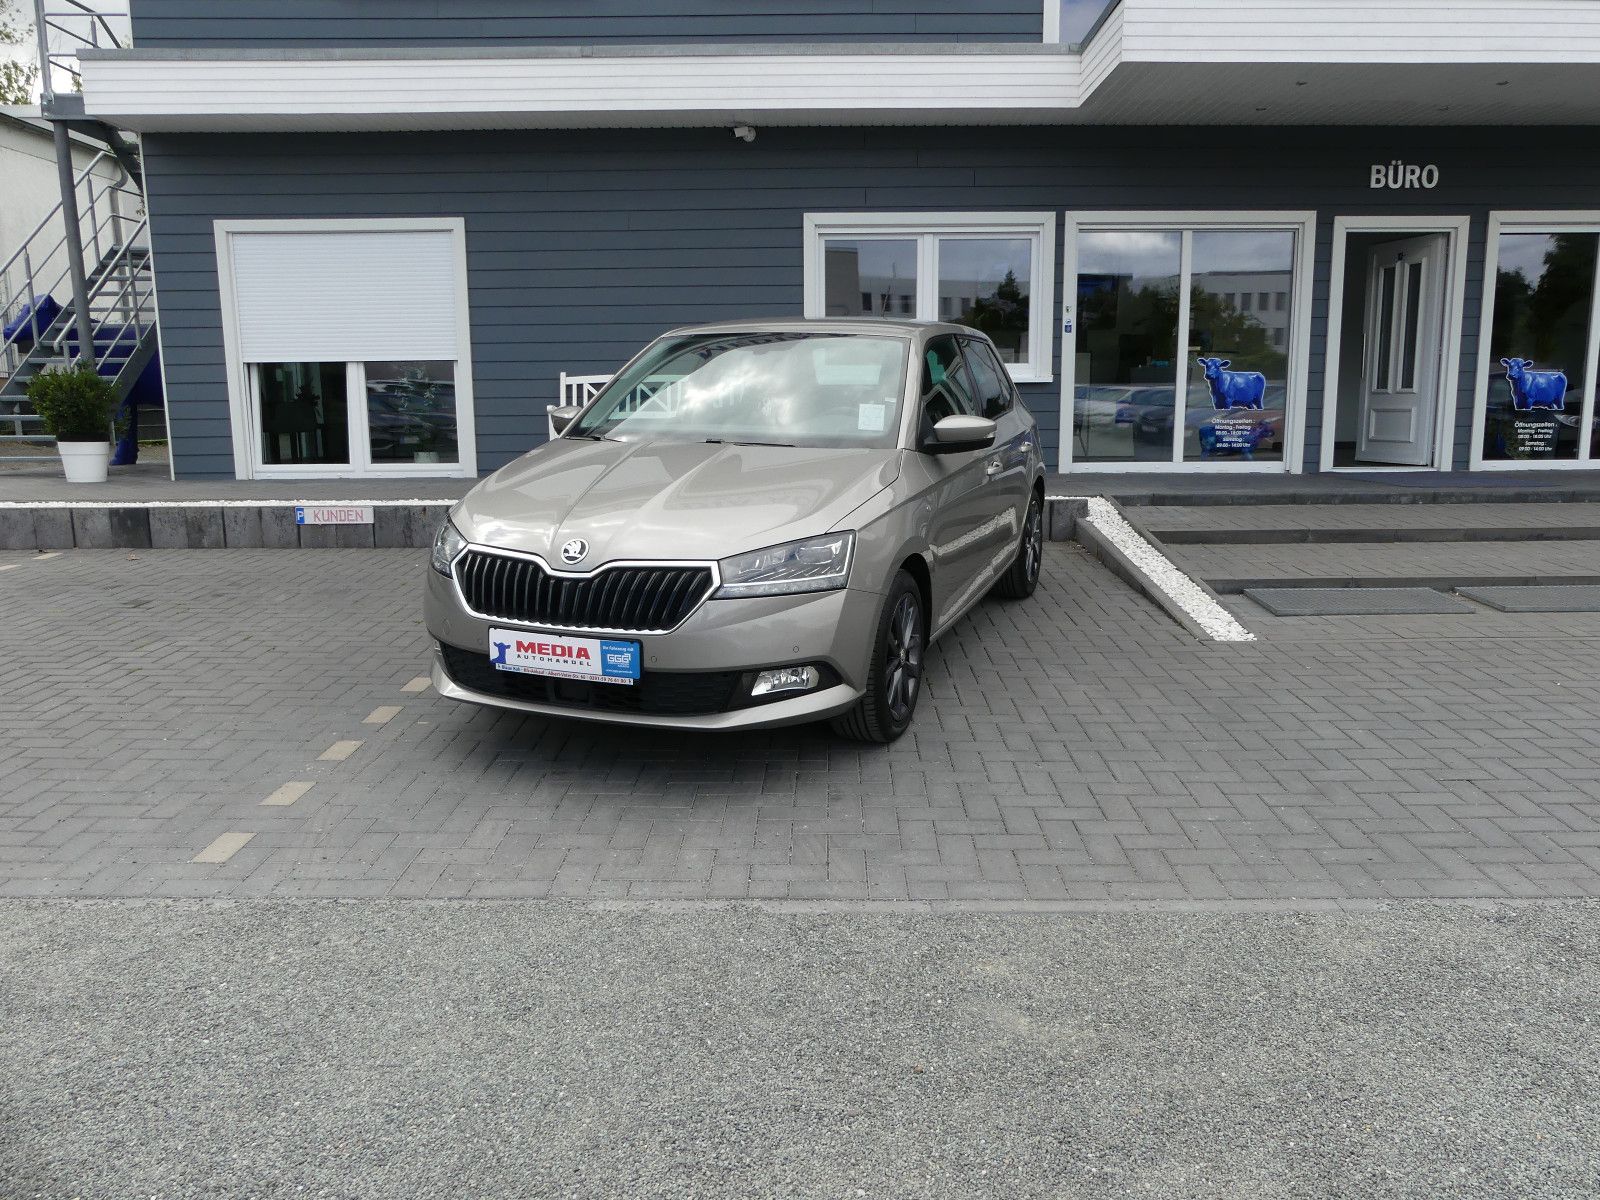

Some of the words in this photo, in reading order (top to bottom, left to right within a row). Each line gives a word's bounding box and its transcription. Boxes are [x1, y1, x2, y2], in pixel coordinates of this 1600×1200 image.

[1370, 160, 1439, 189] BÜRO
[297, 511, 304, 520] P
[313, 509, 364, 522] KUNDEN
[516, 640, 591, 660] MEDIA
[516, 654, 592, 667] AUTOHANDEL
